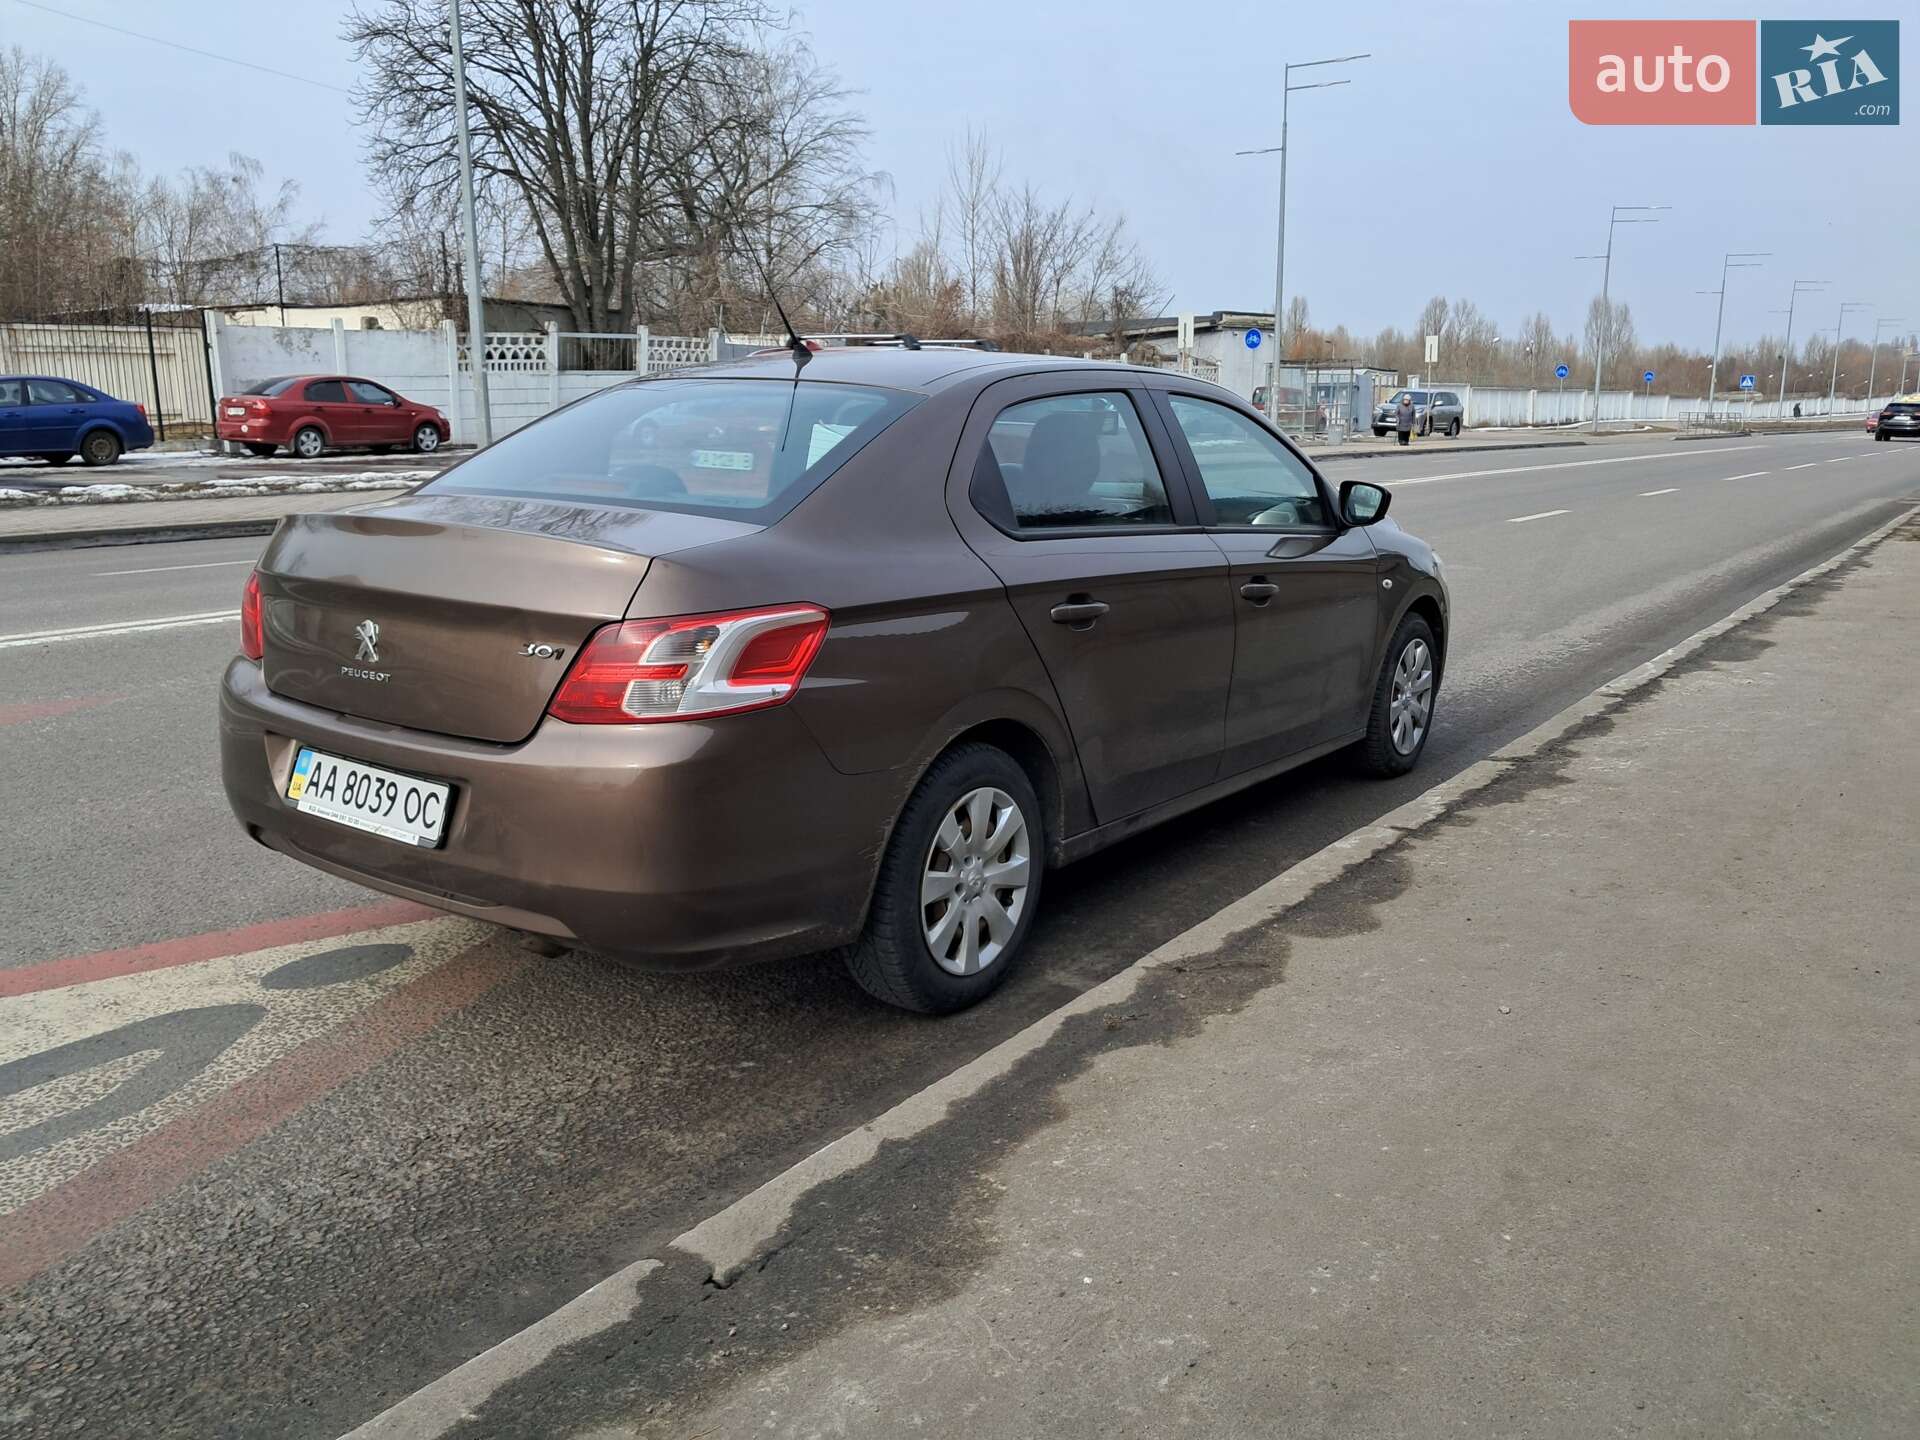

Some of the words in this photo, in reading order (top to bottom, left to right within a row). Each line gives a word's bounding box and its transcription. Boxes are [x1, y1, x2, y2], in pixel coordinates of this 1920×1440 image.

[517, 642, 565, 661] 301
[341, 666, 391, 683] PEUGEOT
[304, 761, 338, 802] AA
[342, 770, 398, 817] 8039
[404, 787, 441, 829] OC
